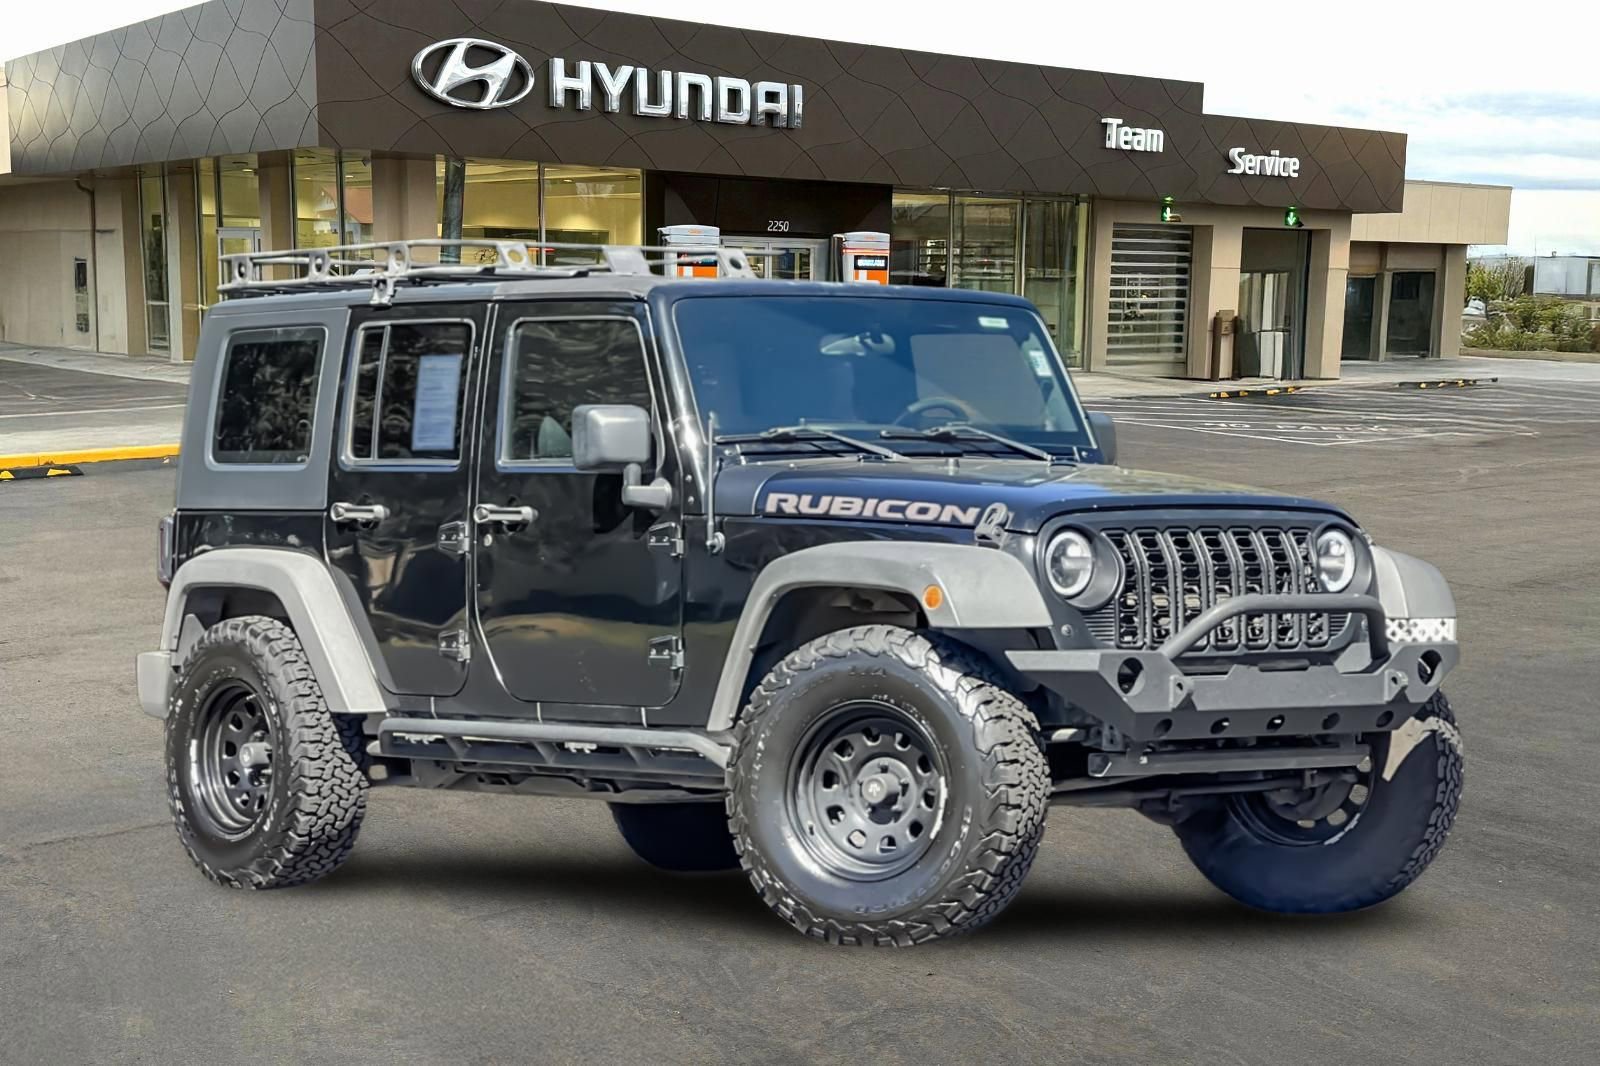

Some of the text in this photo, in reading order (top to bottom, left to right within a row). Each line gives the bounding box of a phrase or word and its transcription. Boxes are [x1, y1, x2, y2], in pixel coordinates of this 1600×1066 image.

[549, 57, 803, 129] HYUNDAI
[1102, 118, 1164, 152] Team
[1227, 147, 1300, 178] Service
[767, 220, 790, 232] 2250
[765, 493, 980, 524] RUBICON
